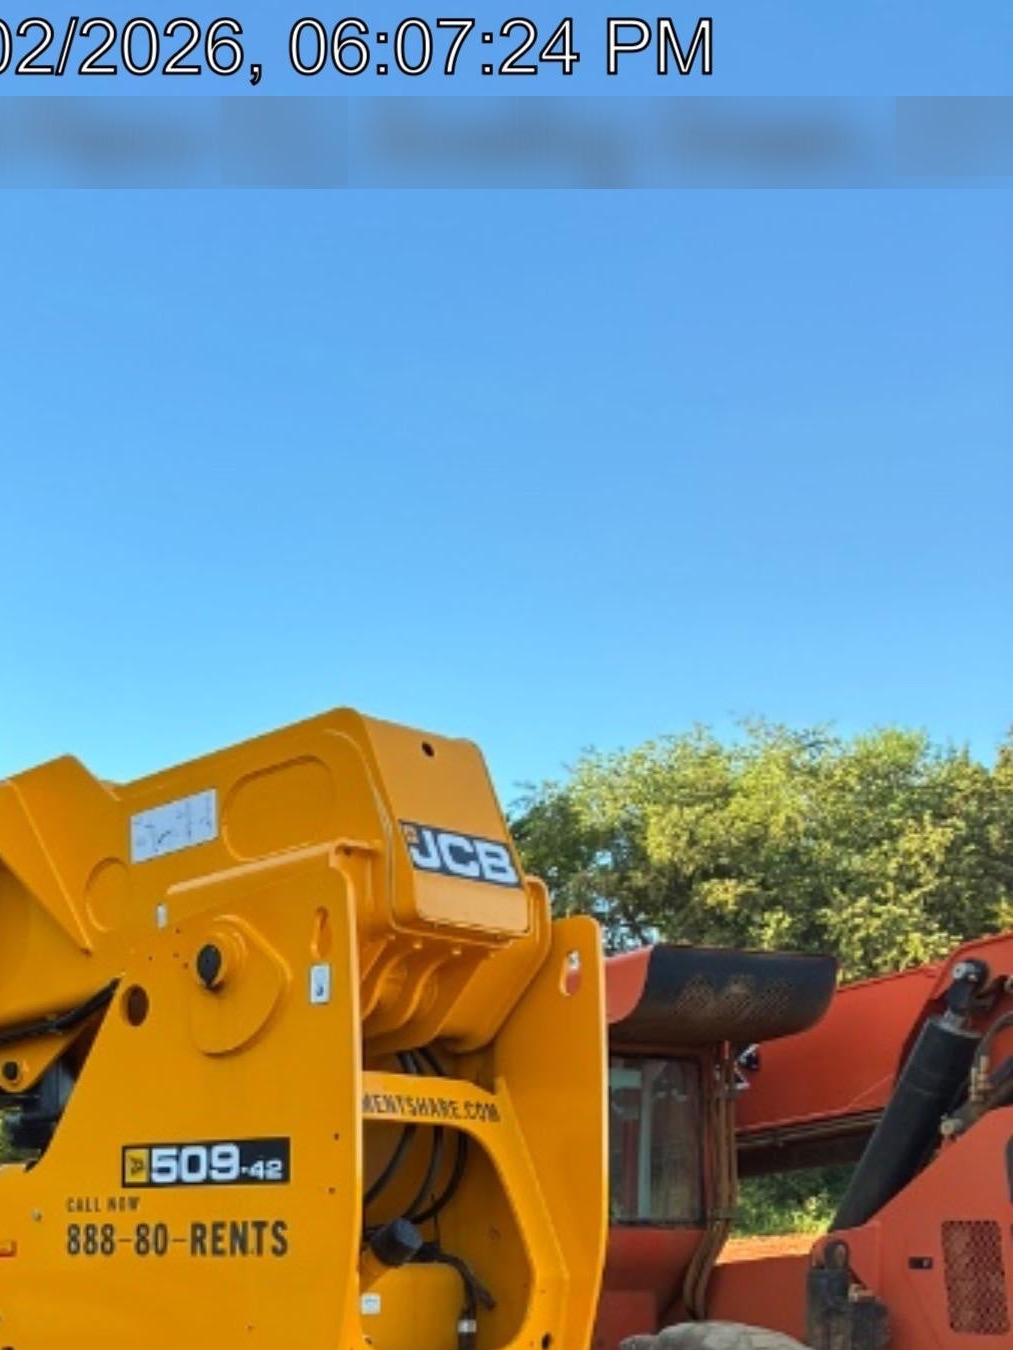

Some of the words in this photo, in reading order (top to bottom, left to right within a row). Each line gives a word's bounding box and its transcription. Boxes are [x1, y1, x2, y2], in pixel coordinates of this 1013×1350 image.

[409, 828, 520, 884] JCB
[67, 1197, 102, 1213] CALL
[106, 1196, 140, 1212] NOW
[67, 1220, 288, 1257] 888-80-RENTS
